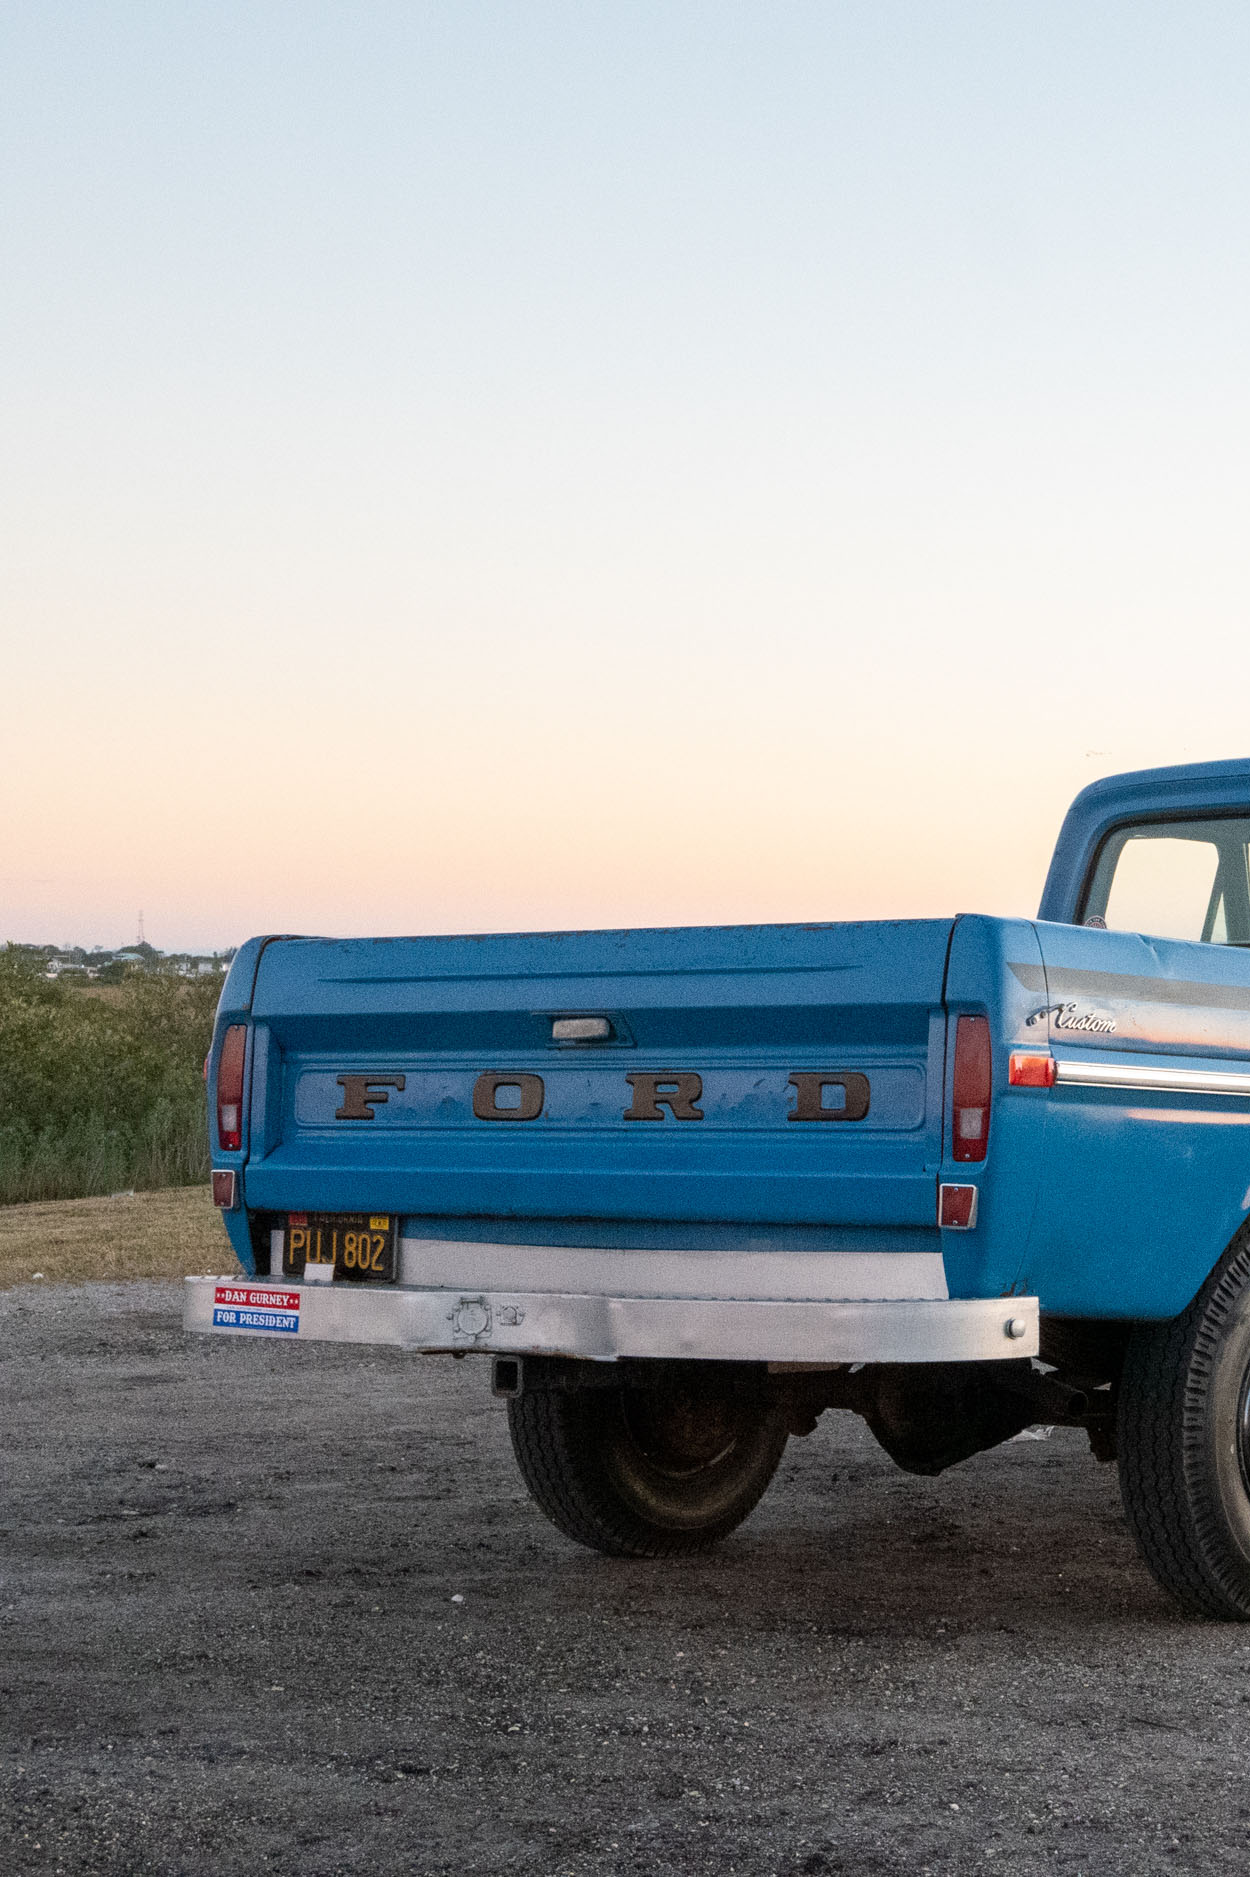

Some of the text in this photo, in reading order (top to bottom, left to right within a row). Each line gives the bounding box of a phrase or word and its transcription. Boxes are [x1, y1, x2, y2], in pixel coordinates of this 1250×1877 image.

[1056, 1002, 1118, 1033] Custom
[335, 1071, 870, 1121] FORD
[344, 1231, 385, 1271] 802
[225, 1290, 290, 1306] DAN GURNEY
[216, 1311, 237, 1323] FOR
[239, 1313, 296, 1328] PRESIDENT
